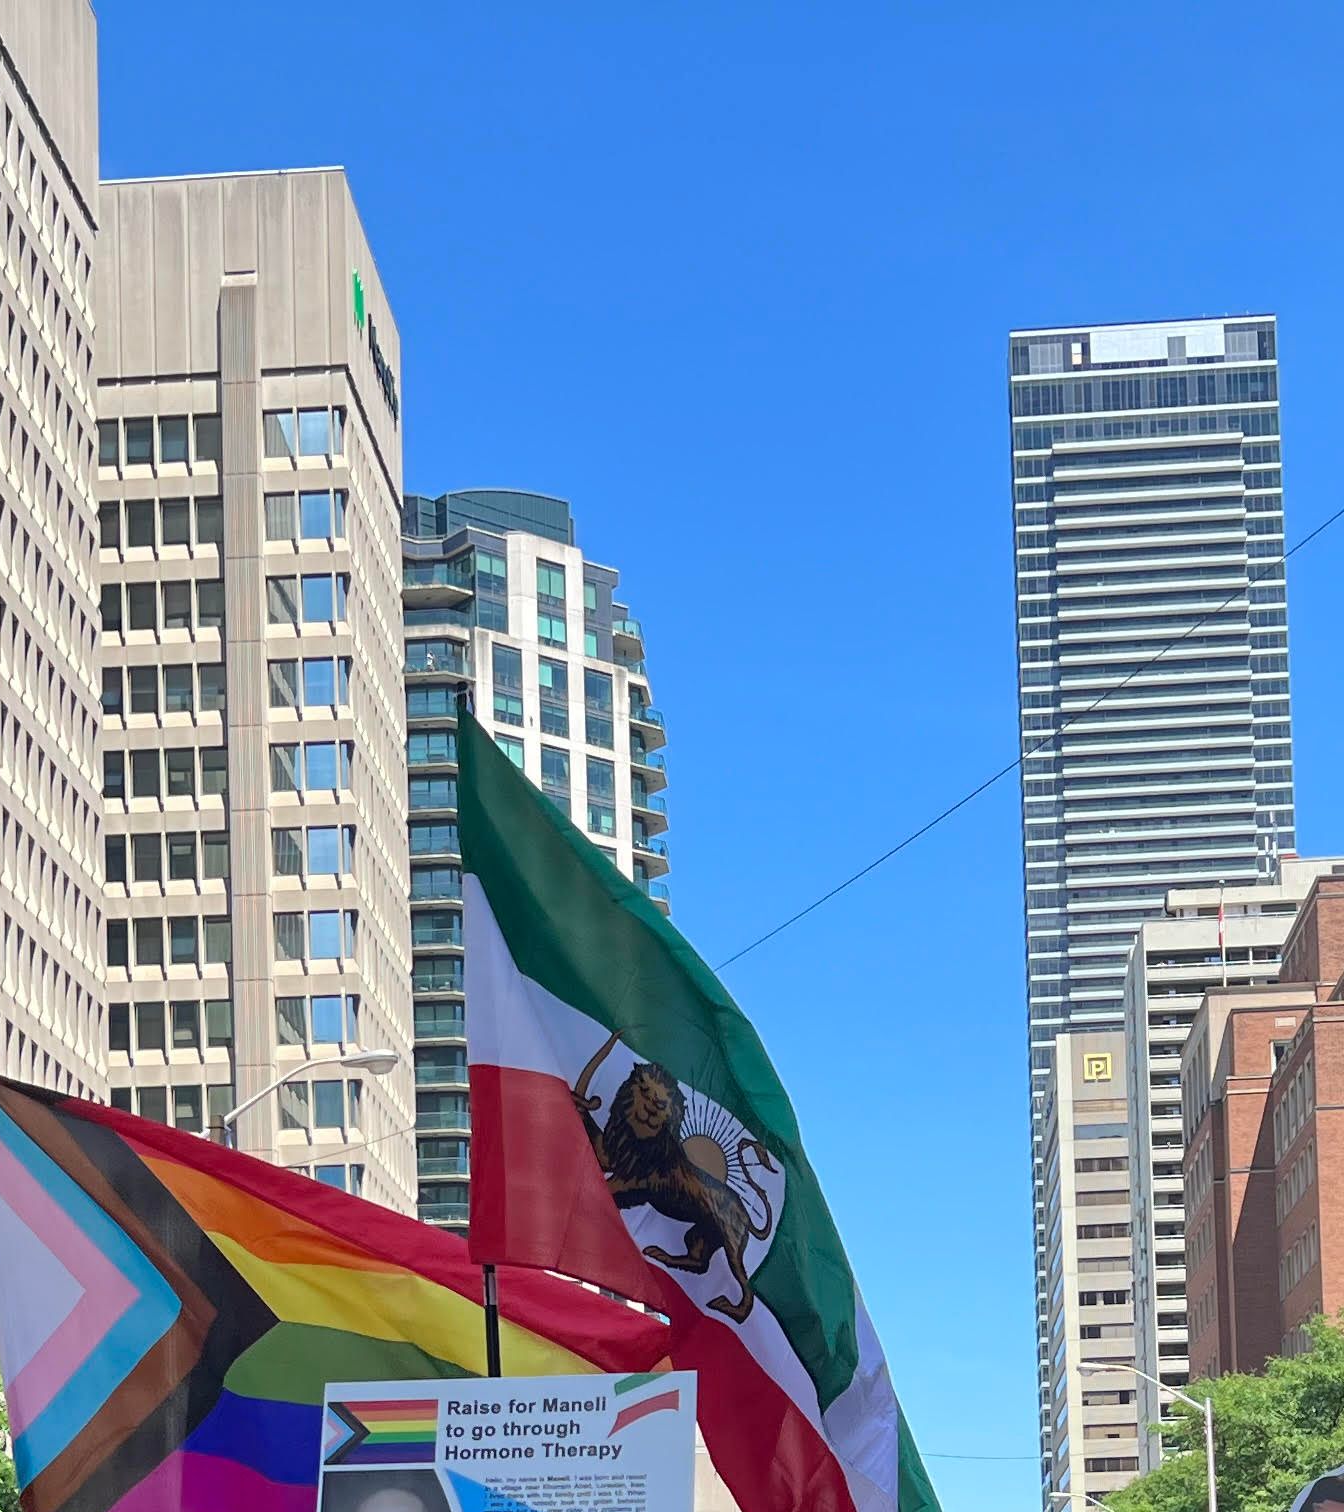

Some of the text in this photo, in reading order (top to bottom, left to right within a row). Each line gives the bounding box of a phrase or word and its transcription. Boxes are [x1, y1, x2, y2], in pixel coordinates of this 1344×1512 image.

[447, 1396, 606, 1415] Raise for Maneli
[445, 1419, 581, 1441] to go through
[445, 1442, 623, 1460] Hormone Therapy
